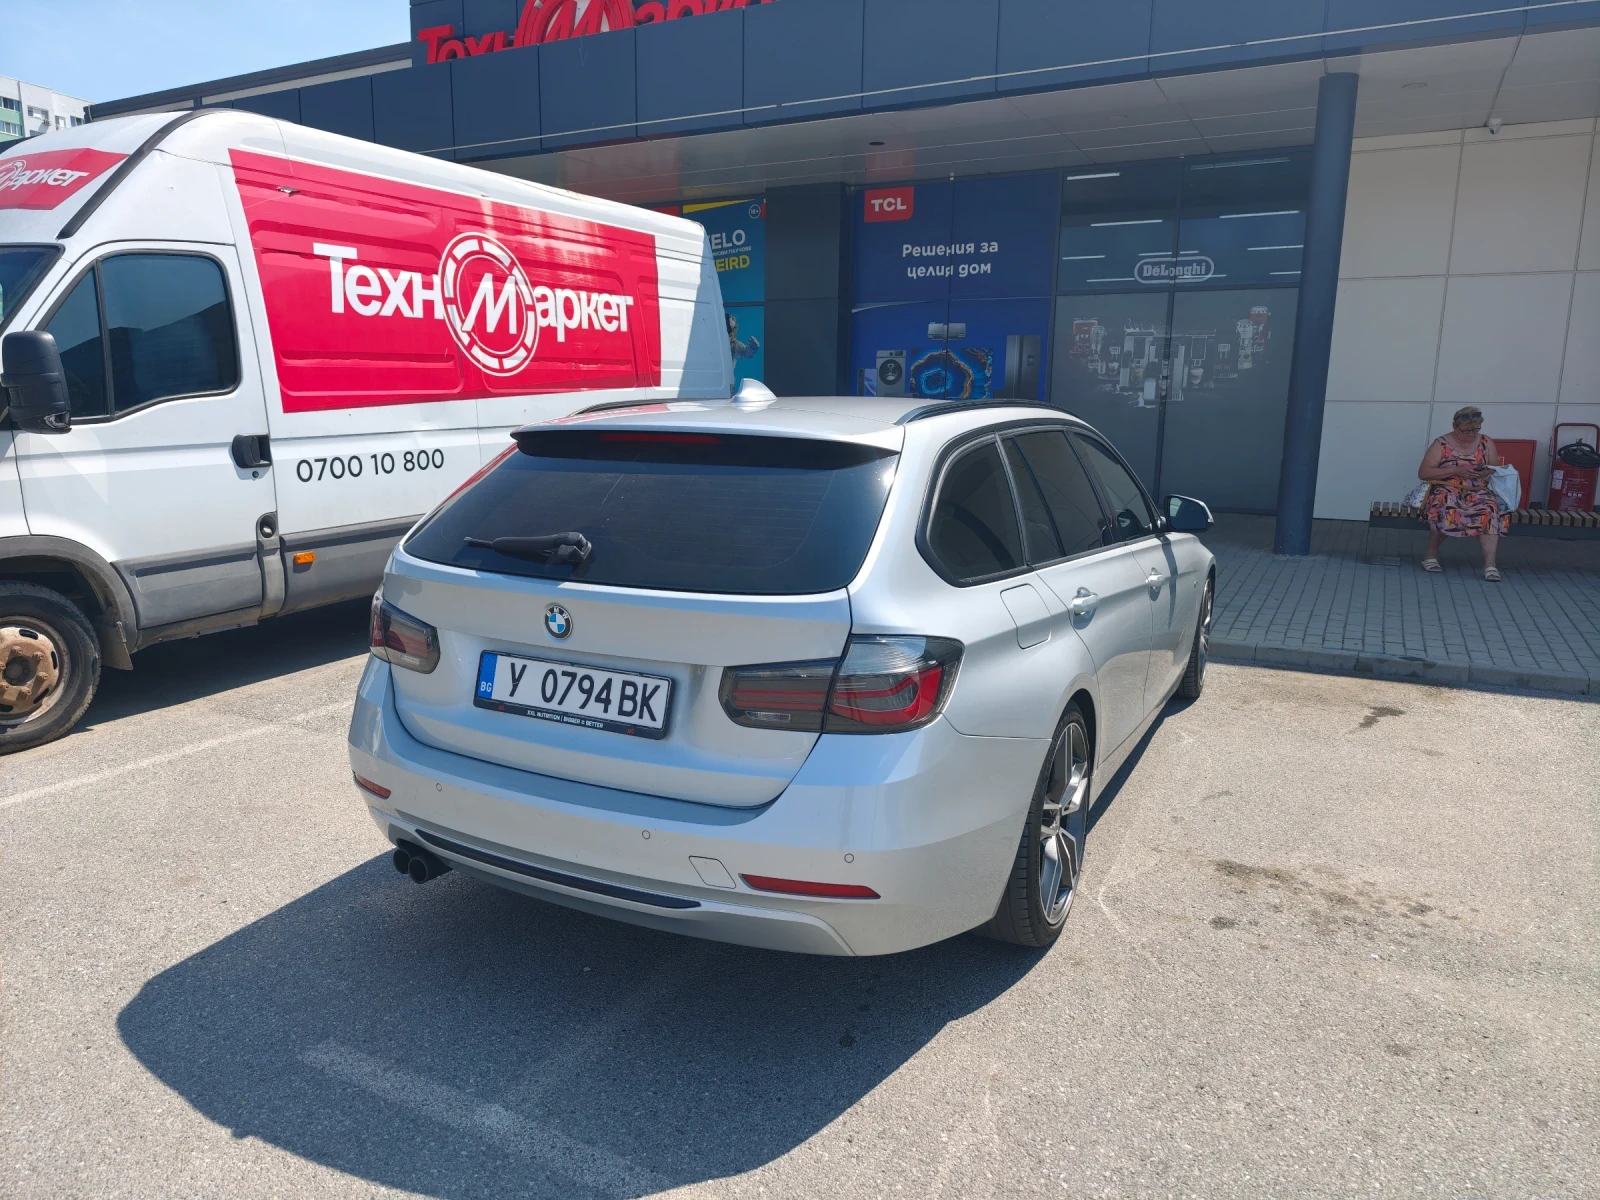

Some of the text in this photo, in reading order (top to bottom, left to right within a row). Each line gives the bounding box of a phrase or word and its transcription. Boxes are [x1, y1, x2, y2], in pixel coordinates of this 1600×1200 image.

[871, 198, 907, 212] TCL
[709, 229, 746, 249] ELO
[902, 241, 999, 258] Решения за
[715, 254, 750, 272] EIRD
[907, 263, 991, 279] целия дом
[296, 448, 445, 483] 0700 10 800
[480, 681, 492, 693] BG
